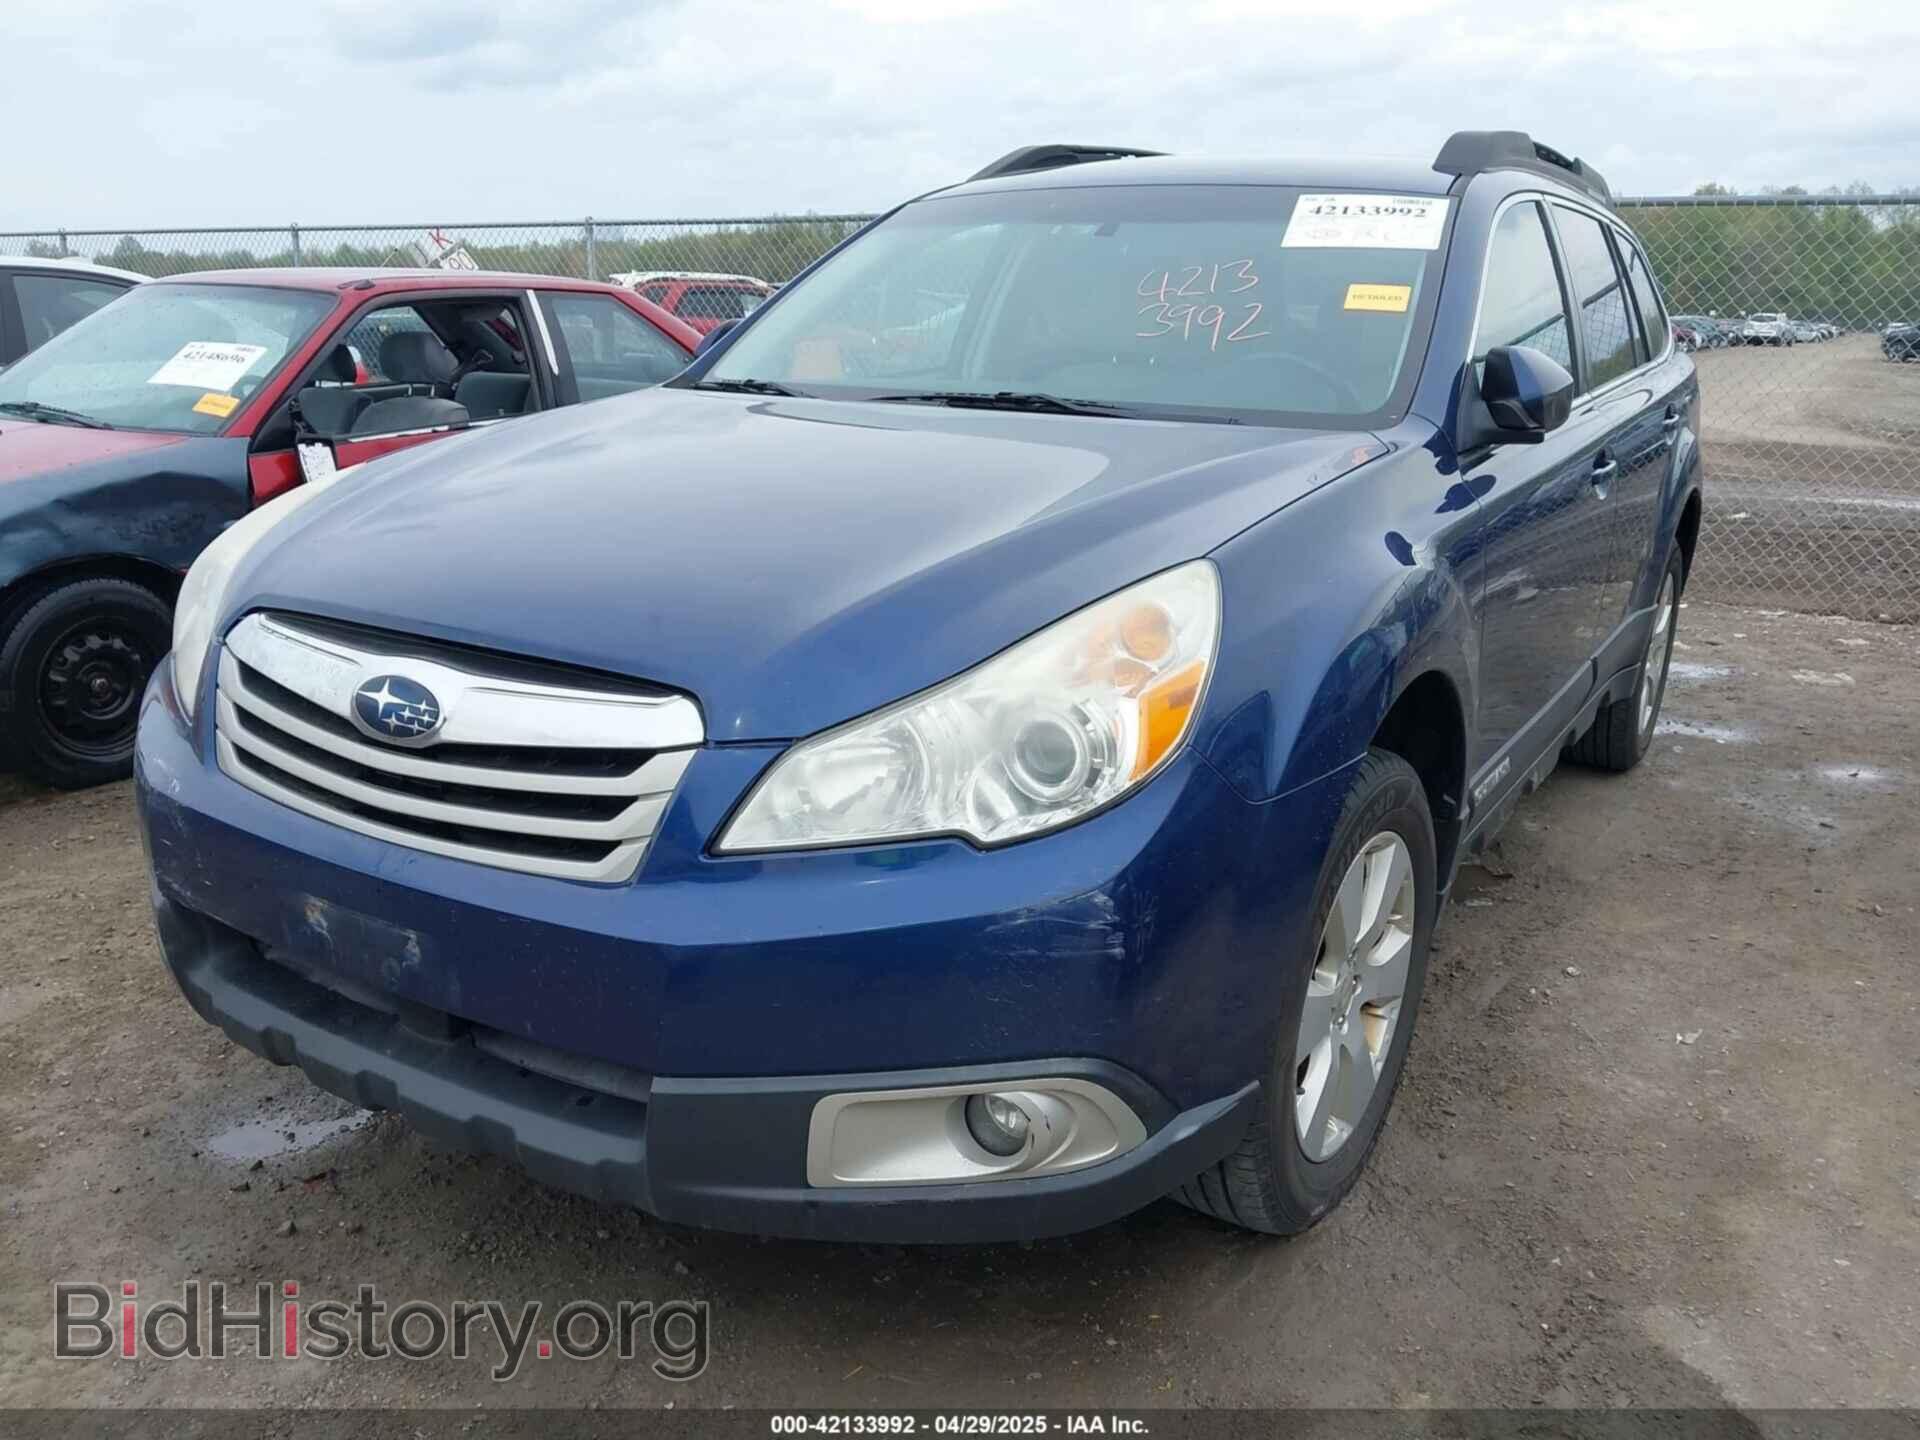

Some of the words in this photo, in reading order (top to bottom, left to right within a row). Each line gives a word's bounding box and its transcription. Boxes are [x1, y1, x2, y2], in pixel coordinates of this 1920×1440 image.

[1309, 205, 1427, 218] 42133992
[1137, 259, 1259, 302] 4213
[1136, 303, 1272, 352] 3992
